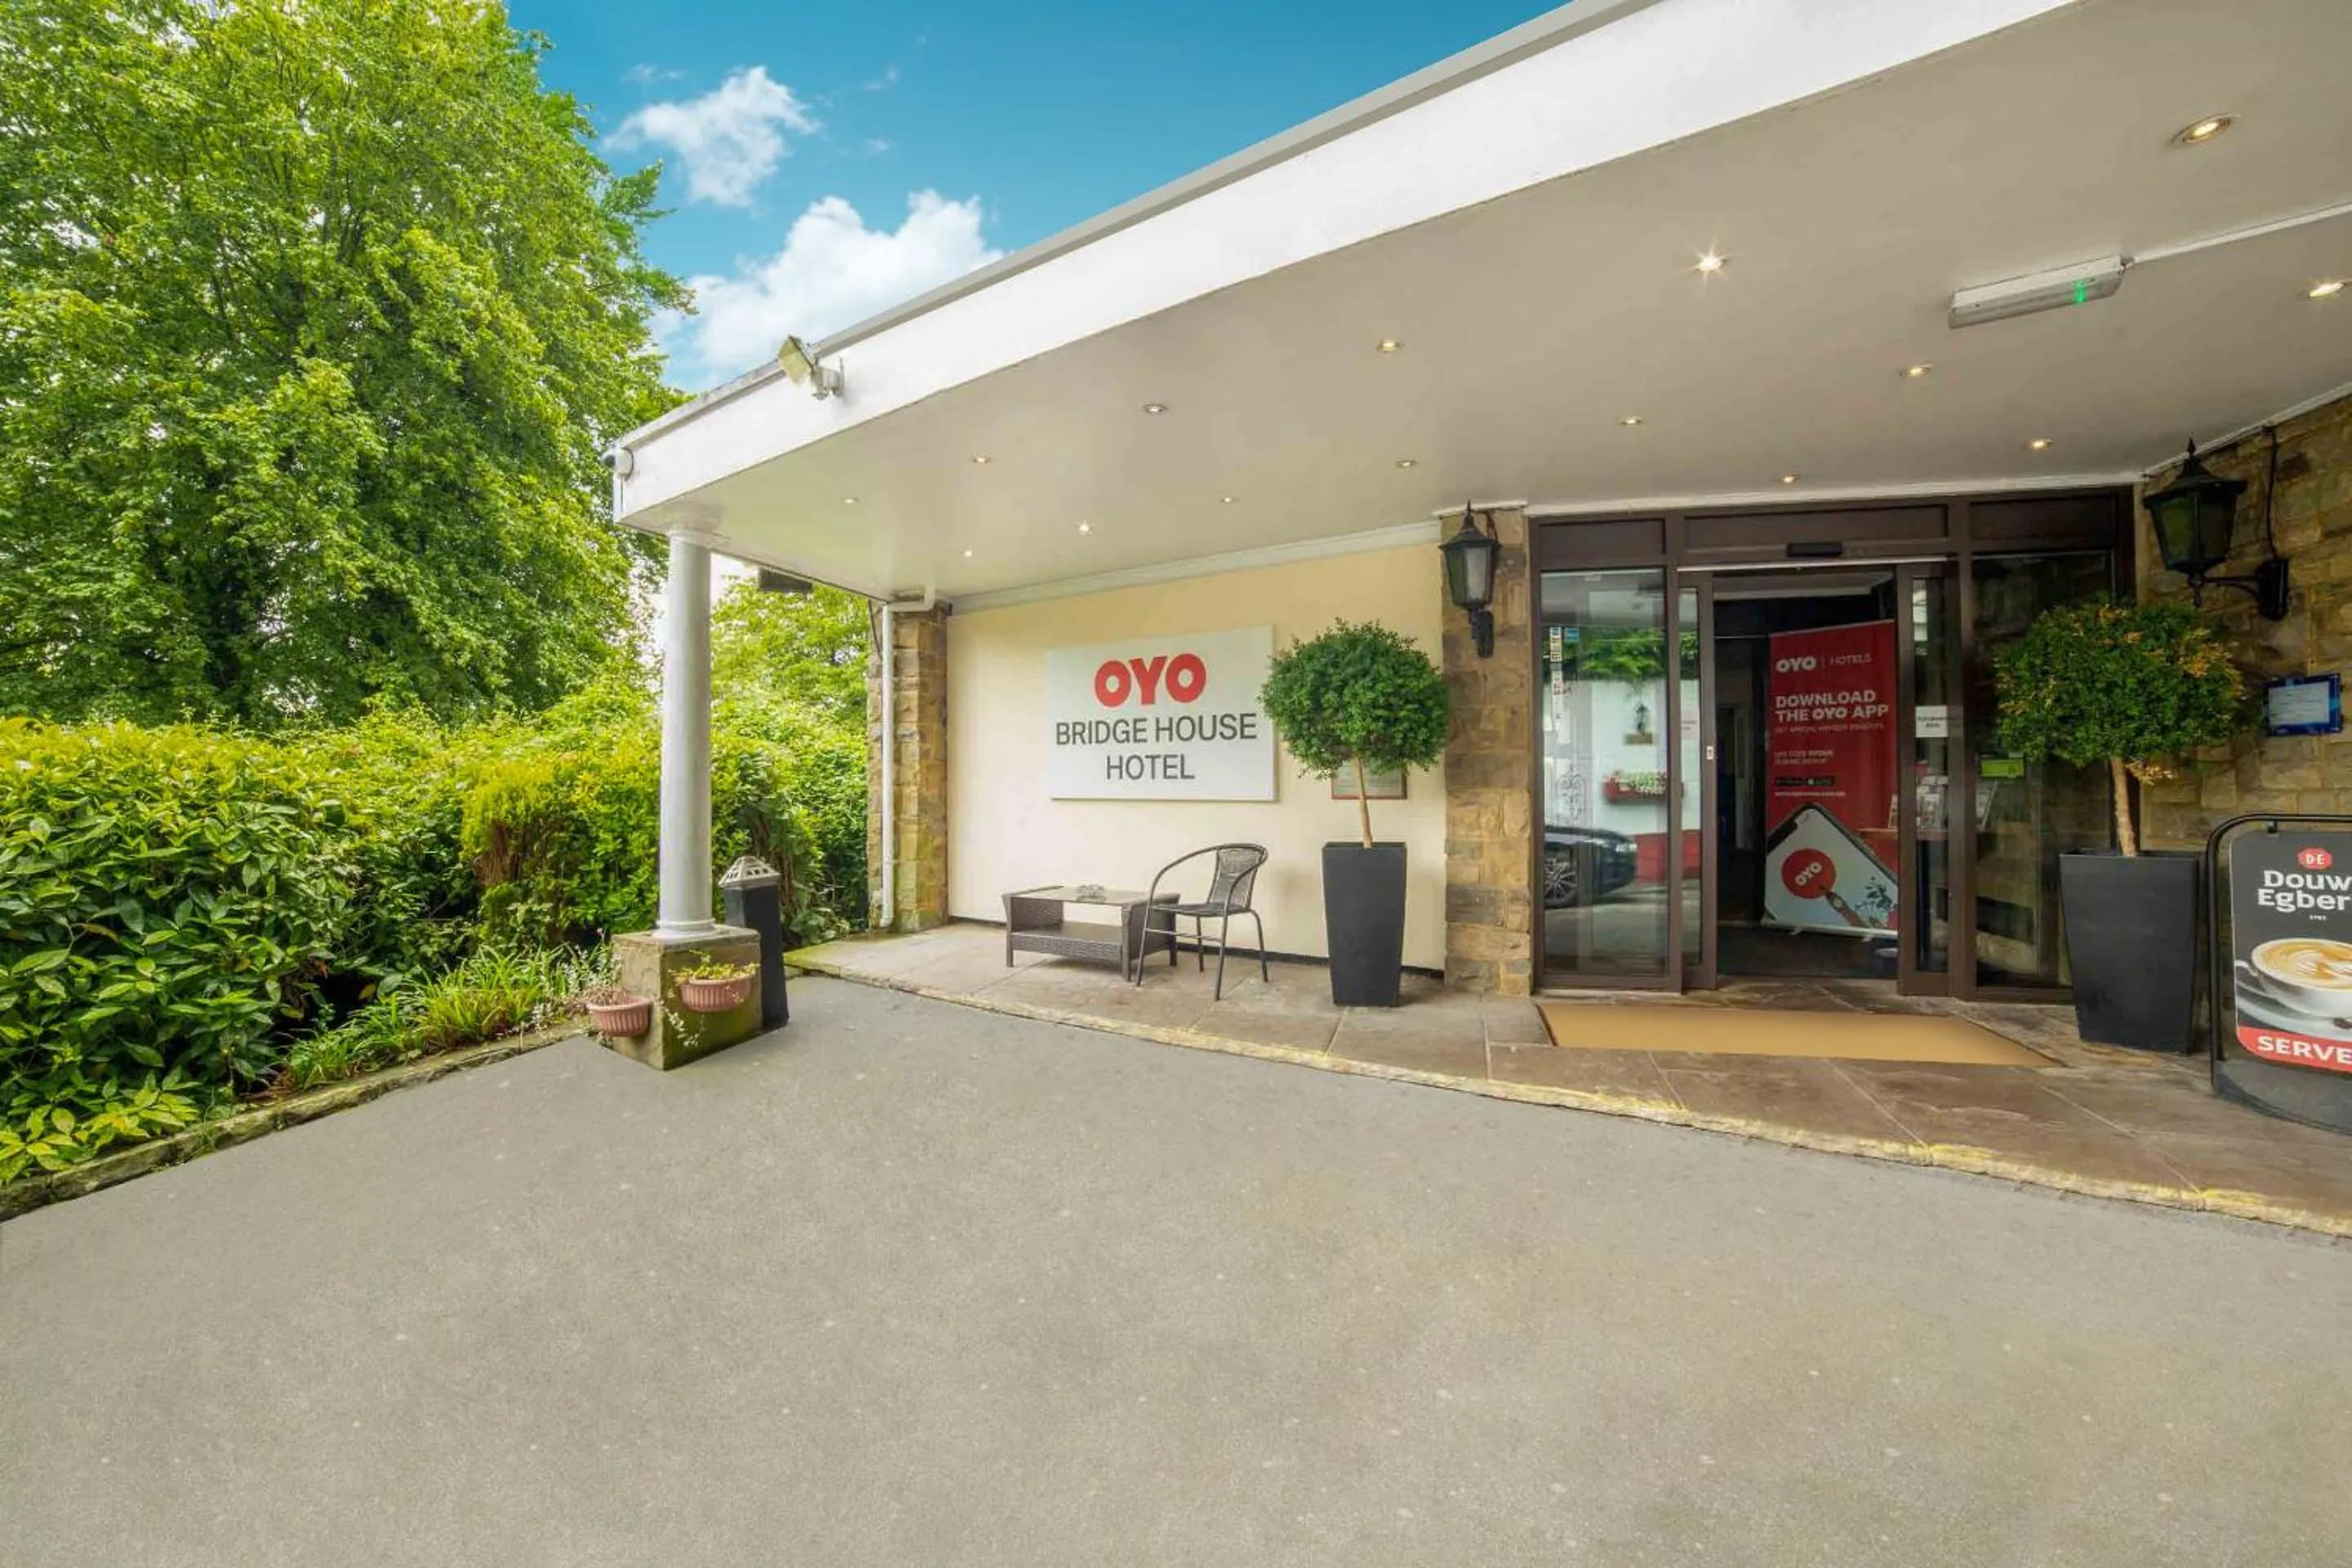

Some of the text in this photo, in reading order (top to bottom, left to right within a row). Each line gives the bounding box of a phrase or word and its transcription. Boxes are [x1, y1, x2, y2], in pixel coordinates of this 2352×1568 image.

[1775, 653, 1872, 673] OYO HOTELS
[1094, 653, 1206, 707] OYO
[1775, 690, 1876, 709] DOWNLOAD
[1775, 704, 1889, 723] THE OYO APP
[1056, 713, 1258, 745] BRIDGE HOUSE
[1106, 754, 1196, 781] HOTEL
[1795, 862, 1822, 886] OYO
[2264, 870, 2352, 892] Douw
[2257, 888, 2351, 913] Egber
[2256, 1035, 2352, 1065] SERVE
